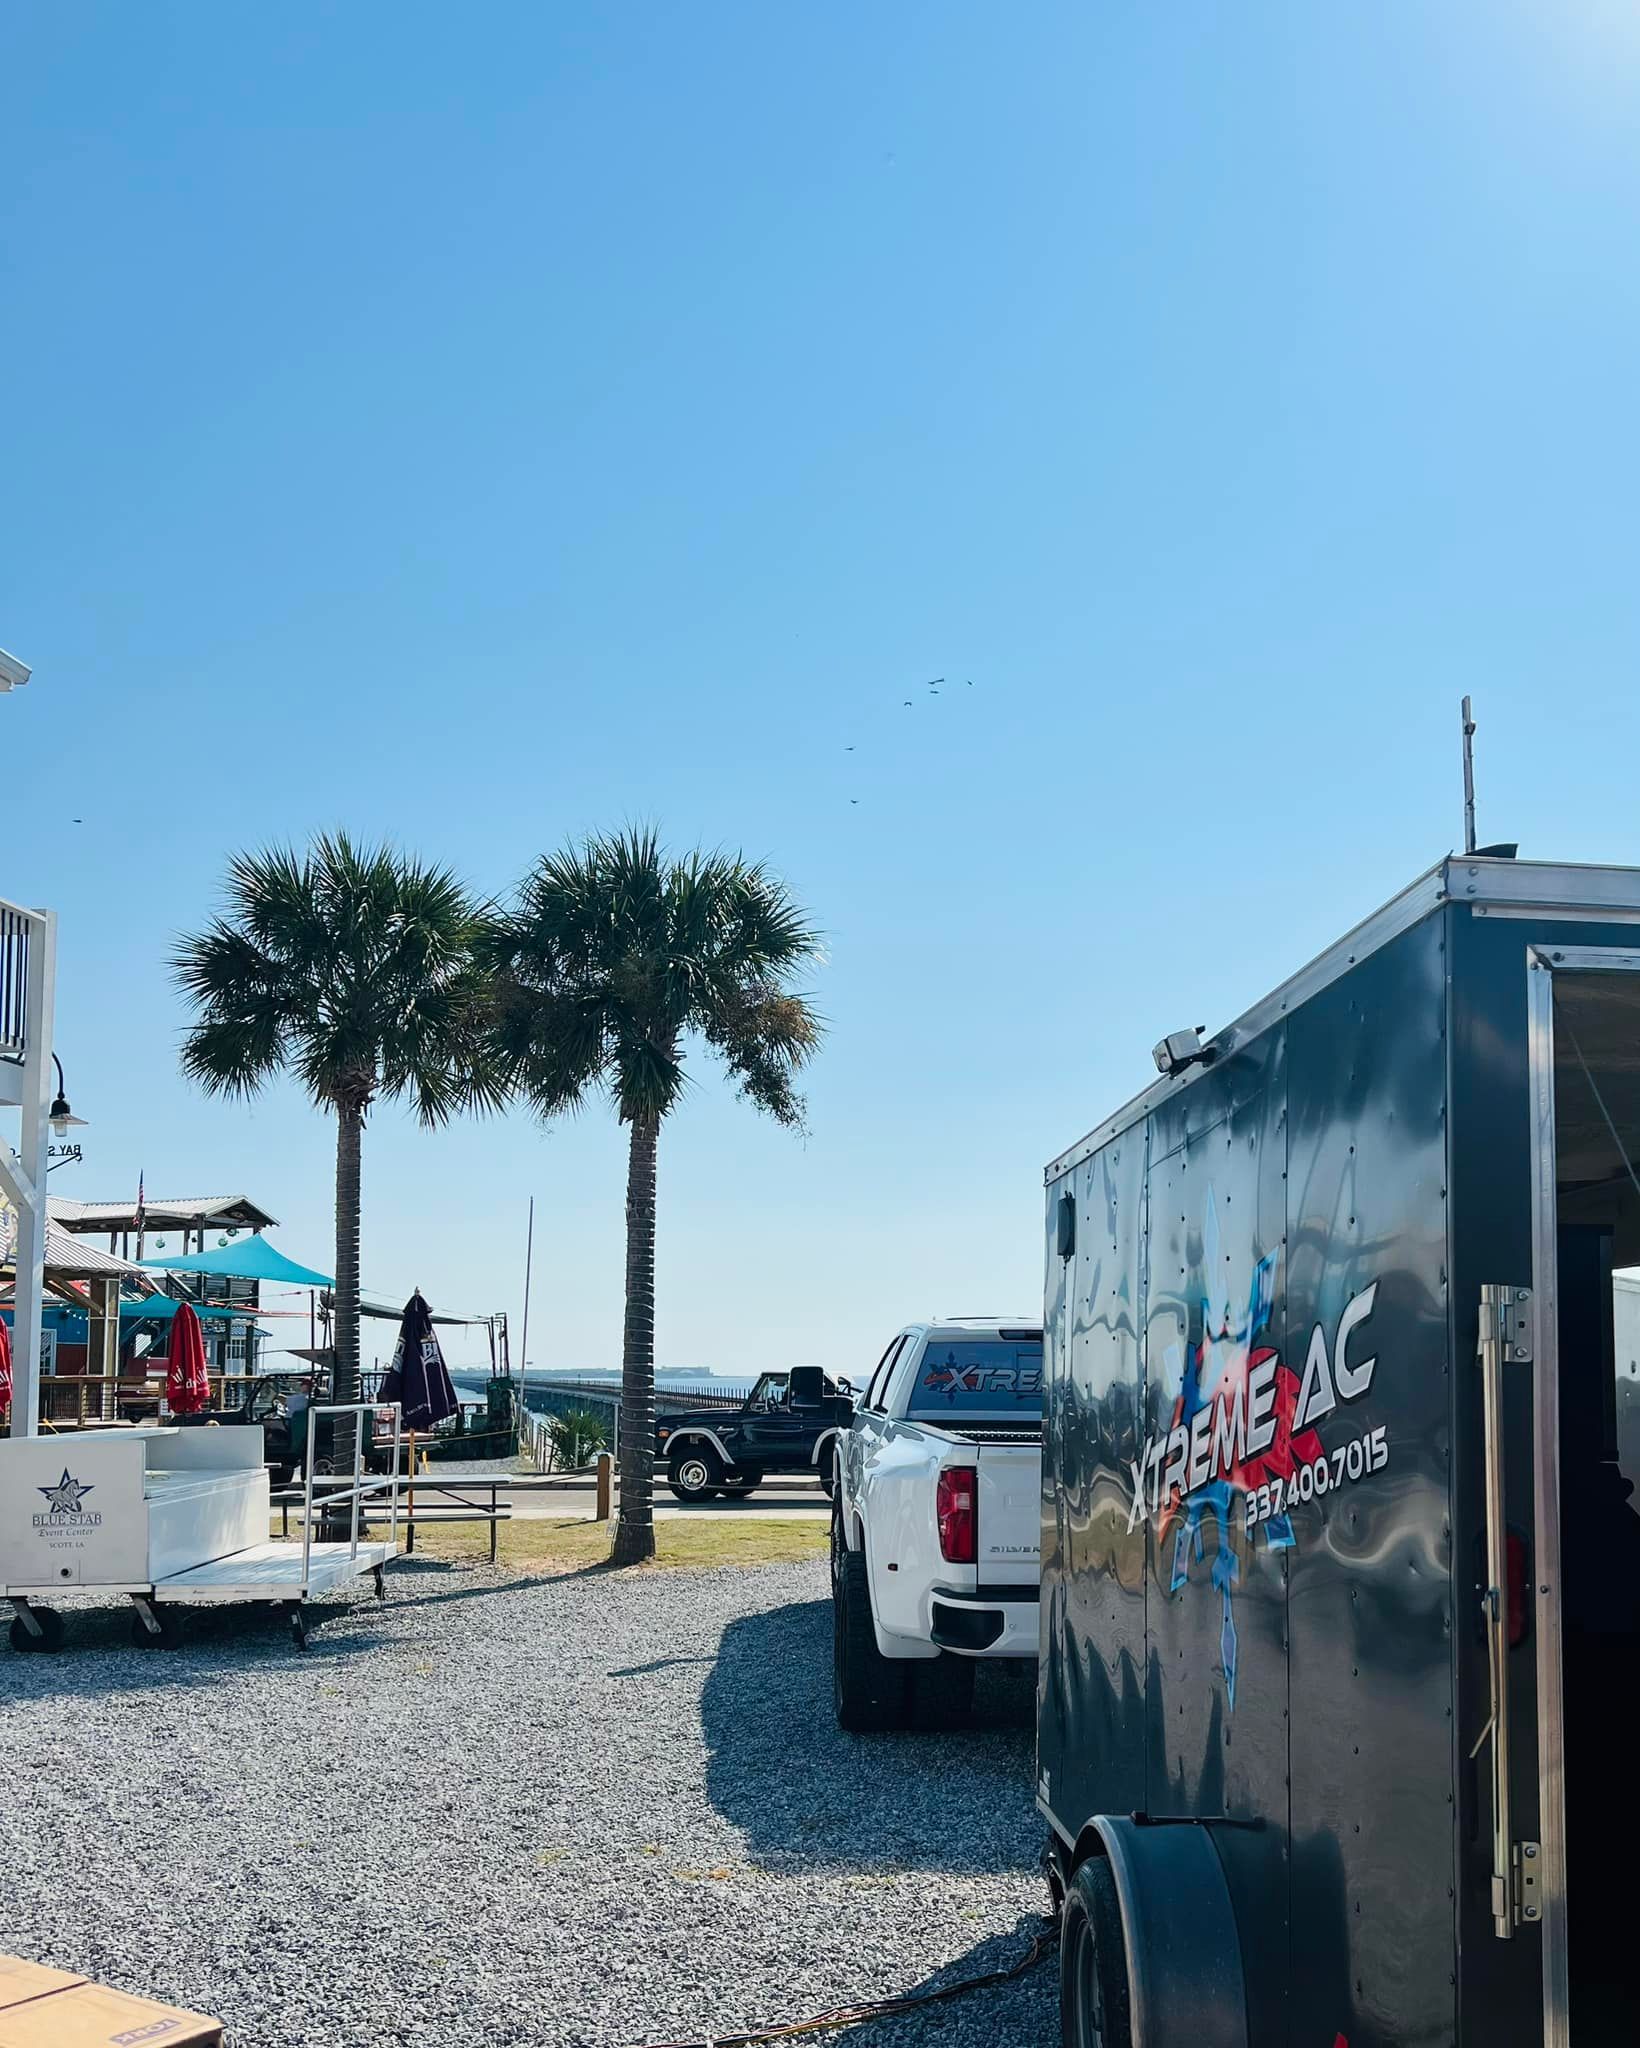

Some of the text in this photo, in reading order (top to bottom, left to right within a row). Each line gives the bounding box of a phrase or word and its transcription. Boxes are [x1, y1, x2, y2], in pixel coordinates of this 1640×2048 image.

[941, 1365, 1042, 1391] XTRE
[1126, 1281, 1378, 1535] XTREME AC
[1245, 1424, 1390, 1528] 337.400.7015
[32, 1513, 102, 1526] BLUE STAR
[38, 1527, 93, 1537] Event Center
